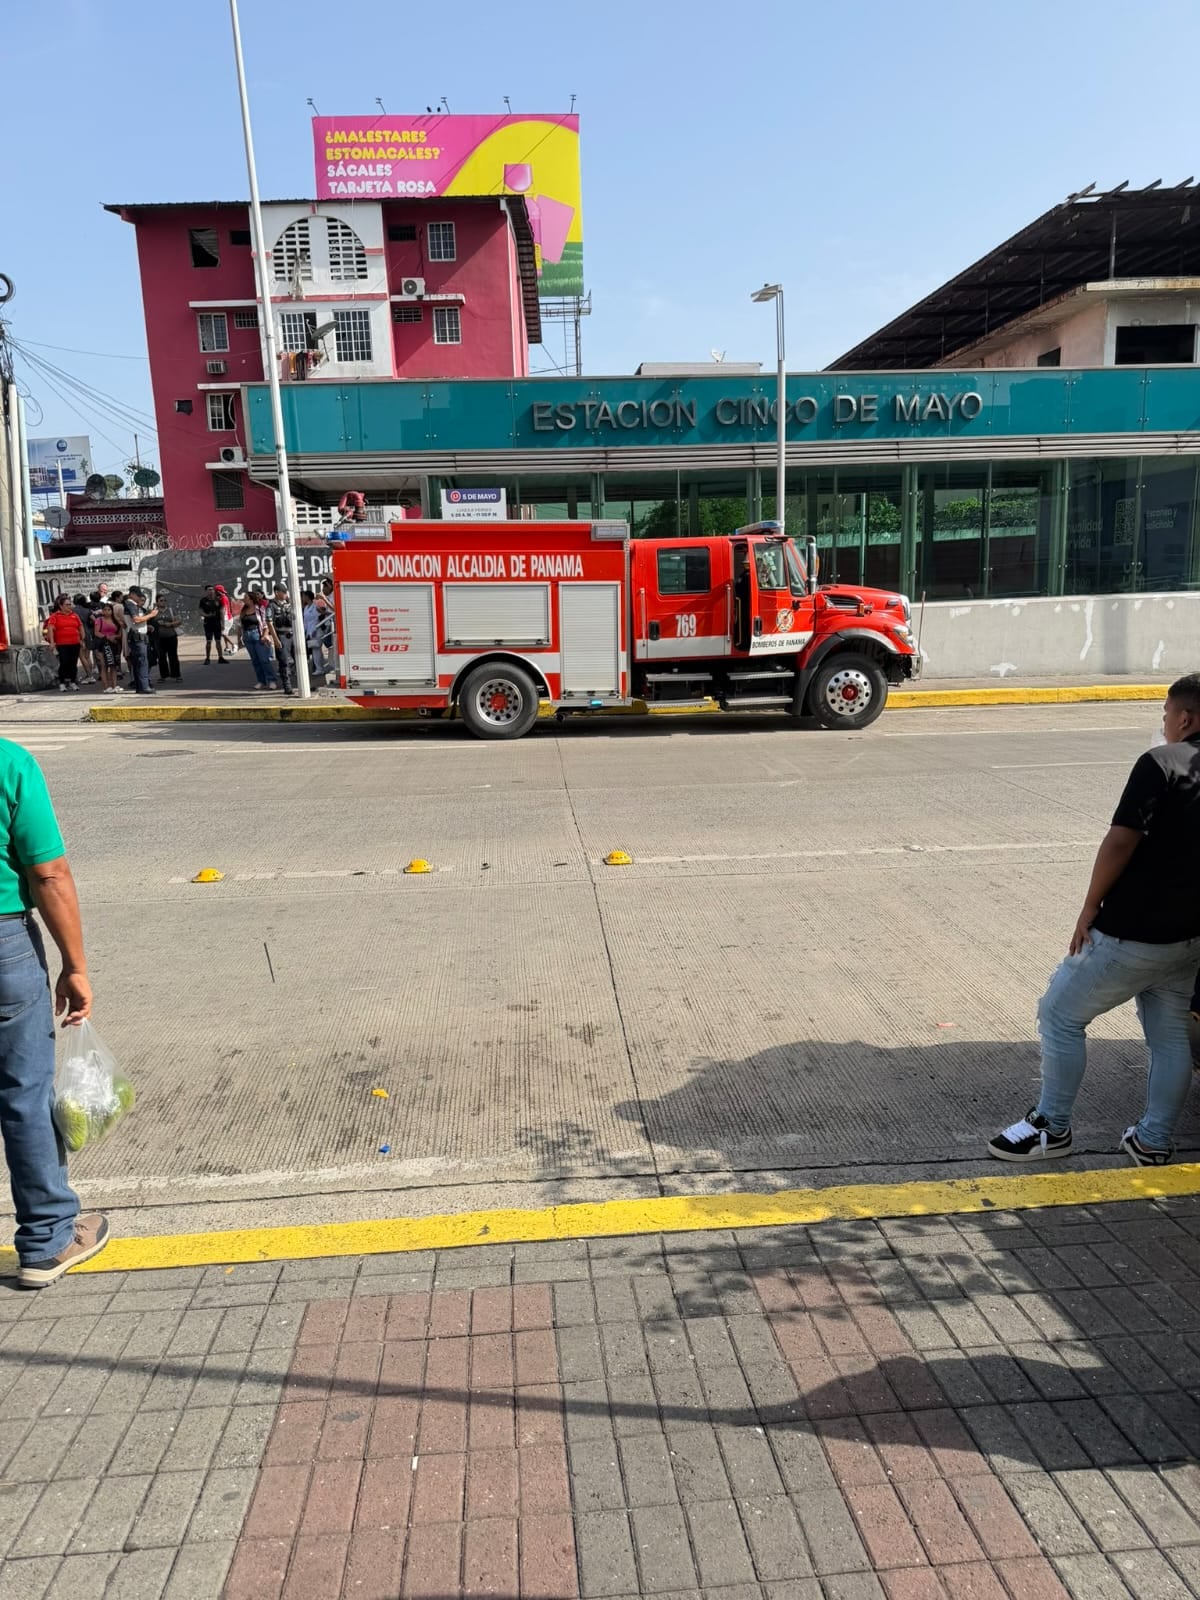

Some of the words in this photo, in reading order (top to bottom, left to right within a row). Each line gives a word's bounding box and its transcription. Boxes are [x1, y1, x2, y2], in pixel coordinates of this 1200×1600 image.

[325, 130, 427, 144] ¿MALESTARES
[326, 147, 440, 161] ESTOMACALES?
[327, 161, 392, 177] SÁCALES
[328, 181, 392, 194] TARJETA
[397, 180, 436, 193] ROSA
[531, 398, 697, 432] ESTACION
[716, 395, 818, 426] CINCO
[834, 393, 879, 423] DE
[895, 391, 984, 422] MAYO
[245, 556, 275, 578] 20
[376, 555, 442, 578] DONACION
[447, 555, 505, 578] ALCALDIA
[510, 555, 527, 578] DE
[530, 555, 584, 577] PANAMA
[675, 613, 697, 637] 769
[383, 644, 409, 652] 103
[752, 641, 777, 649] BOMBEROS
[785, 638, 806, 646] PANAMA
